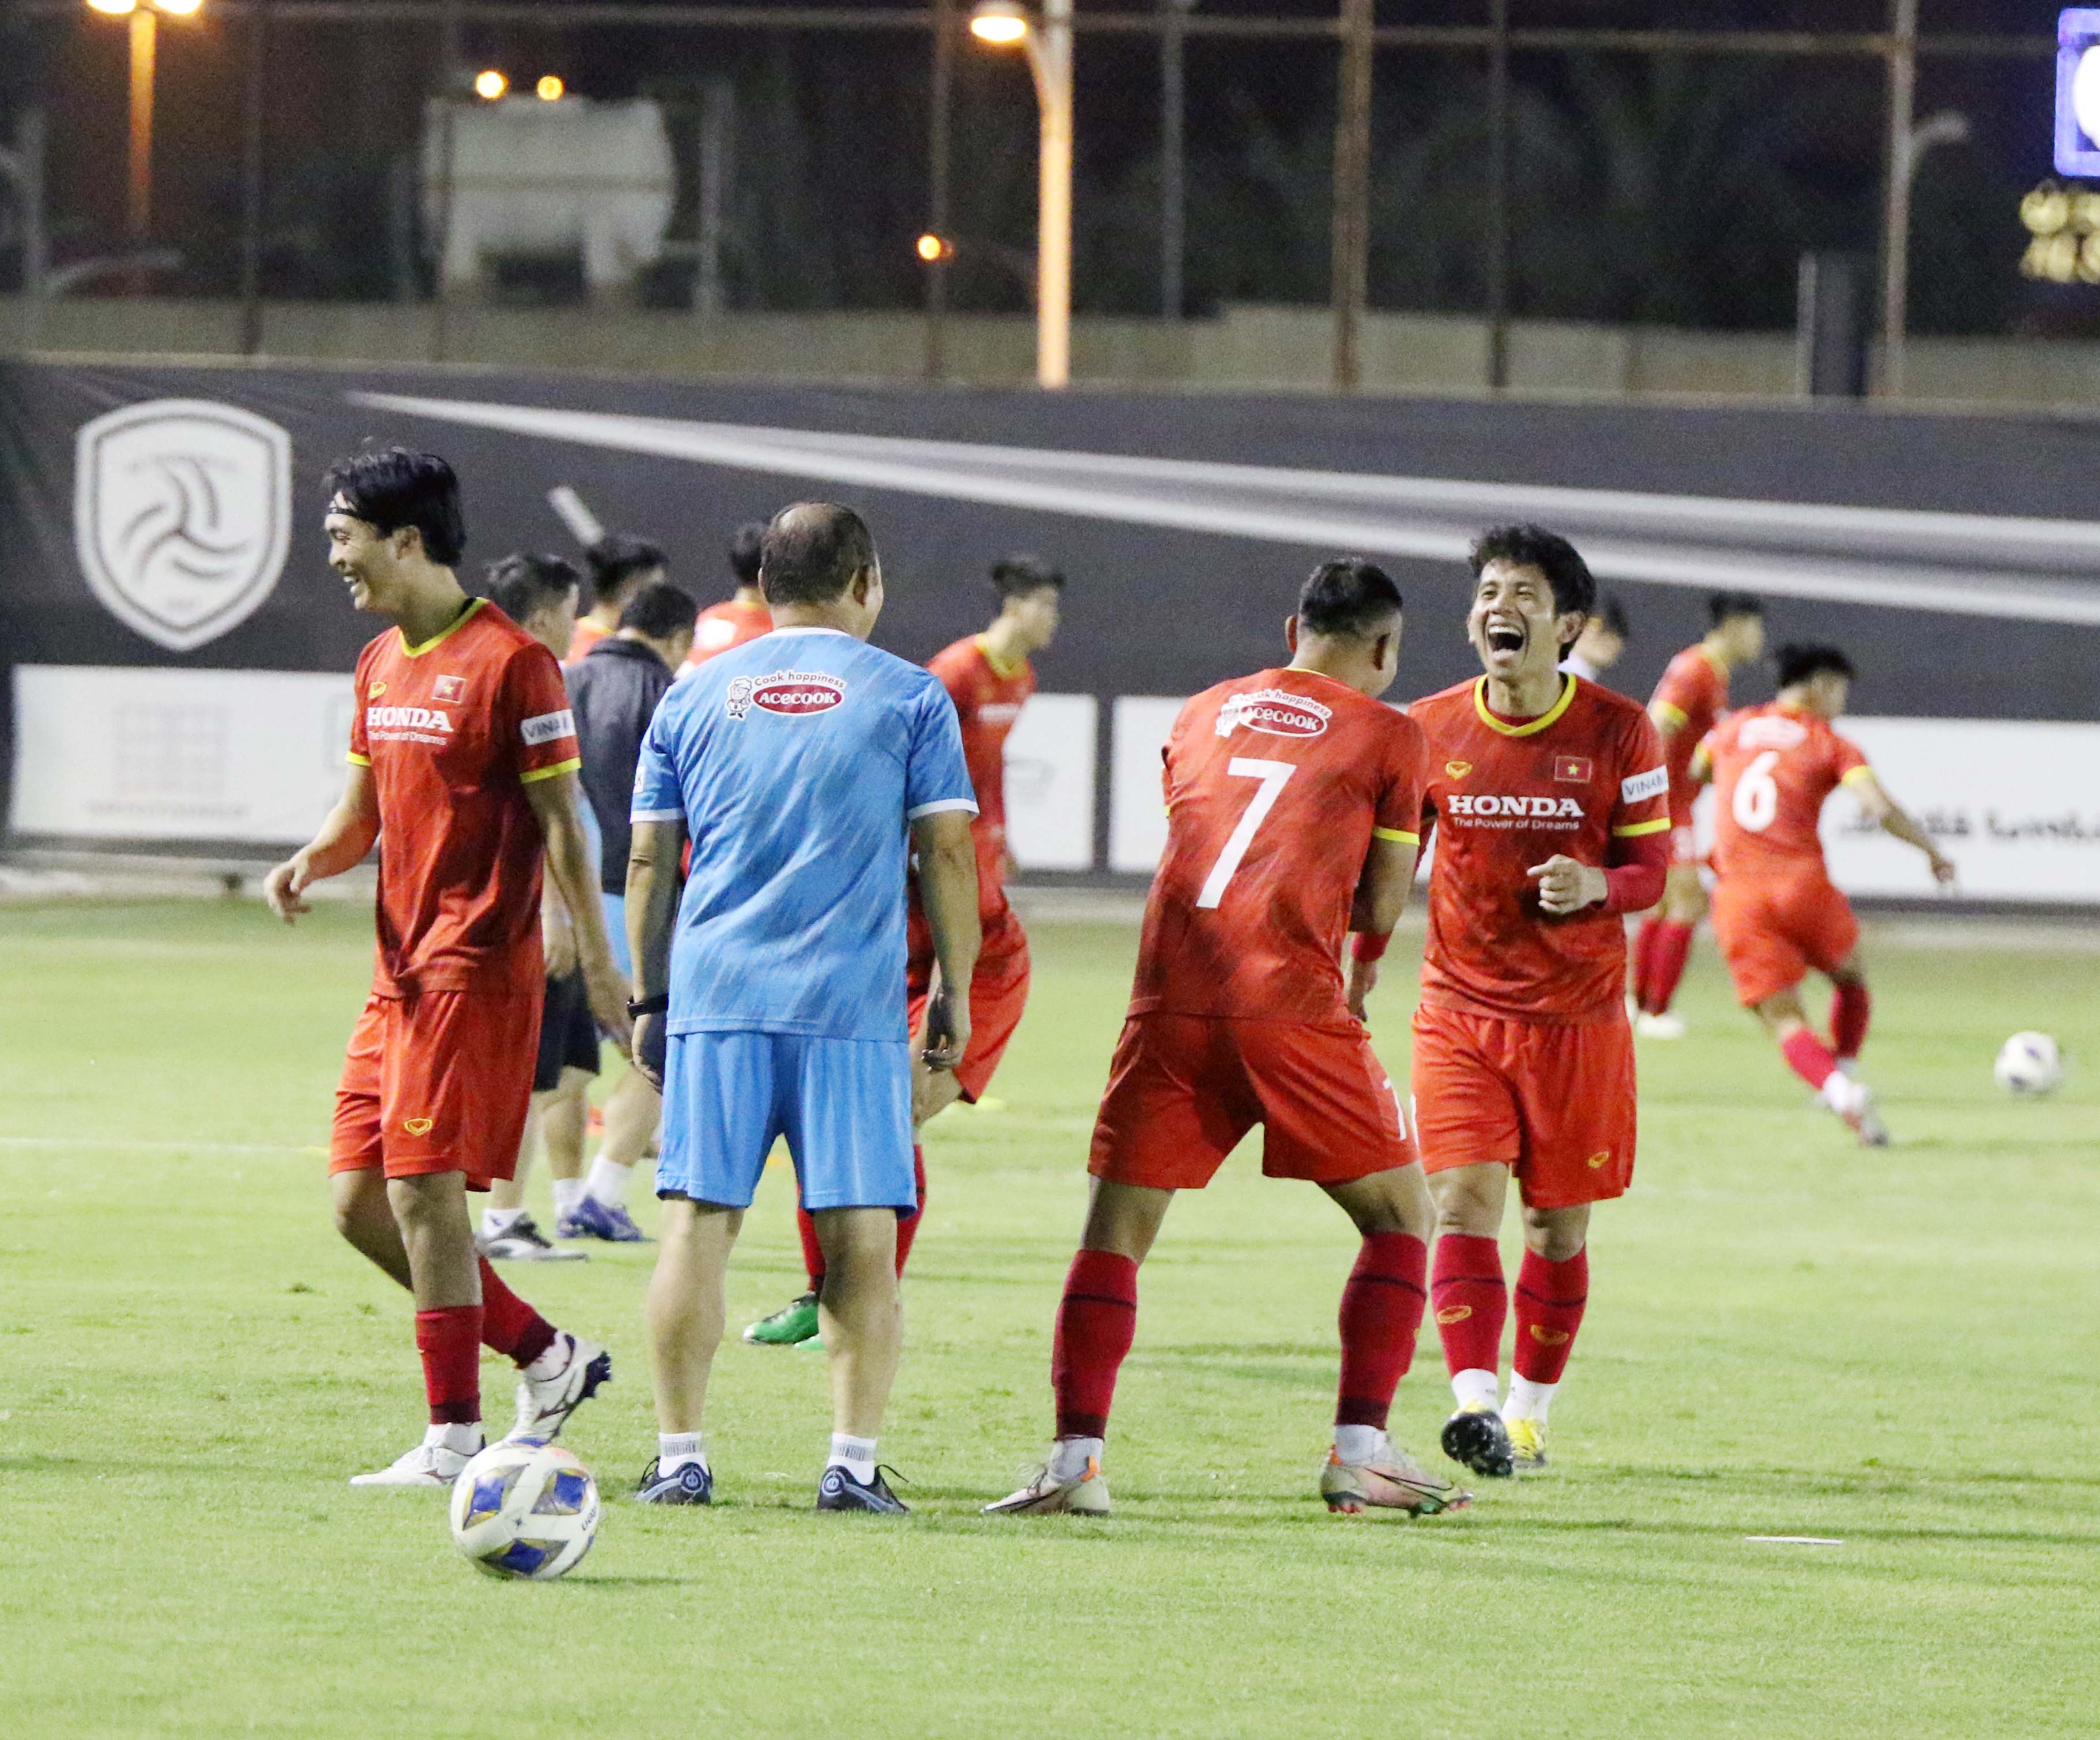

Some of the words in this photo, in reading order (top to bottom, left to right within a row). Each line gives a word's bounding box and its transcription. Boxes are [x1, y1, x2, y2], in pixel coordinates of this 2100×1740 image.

[755, 673, 784, 686] Cook
[788, 672, 845, 688] happiness
[1275, 692, 1330, 717] happiness
[366, 707, 454, 732] HONDA
[1733, 750, 1779, 832] 6
[1447, 795, 1585, 818] HONDA
[1195, 756, 1297, 909] 7
[1454, 816, 1473, 827] The
[1475, 817, 1513, 828] Power
[1516, 818, 1529, 828] of
[1531, 819, 1579, 830] Dreams
